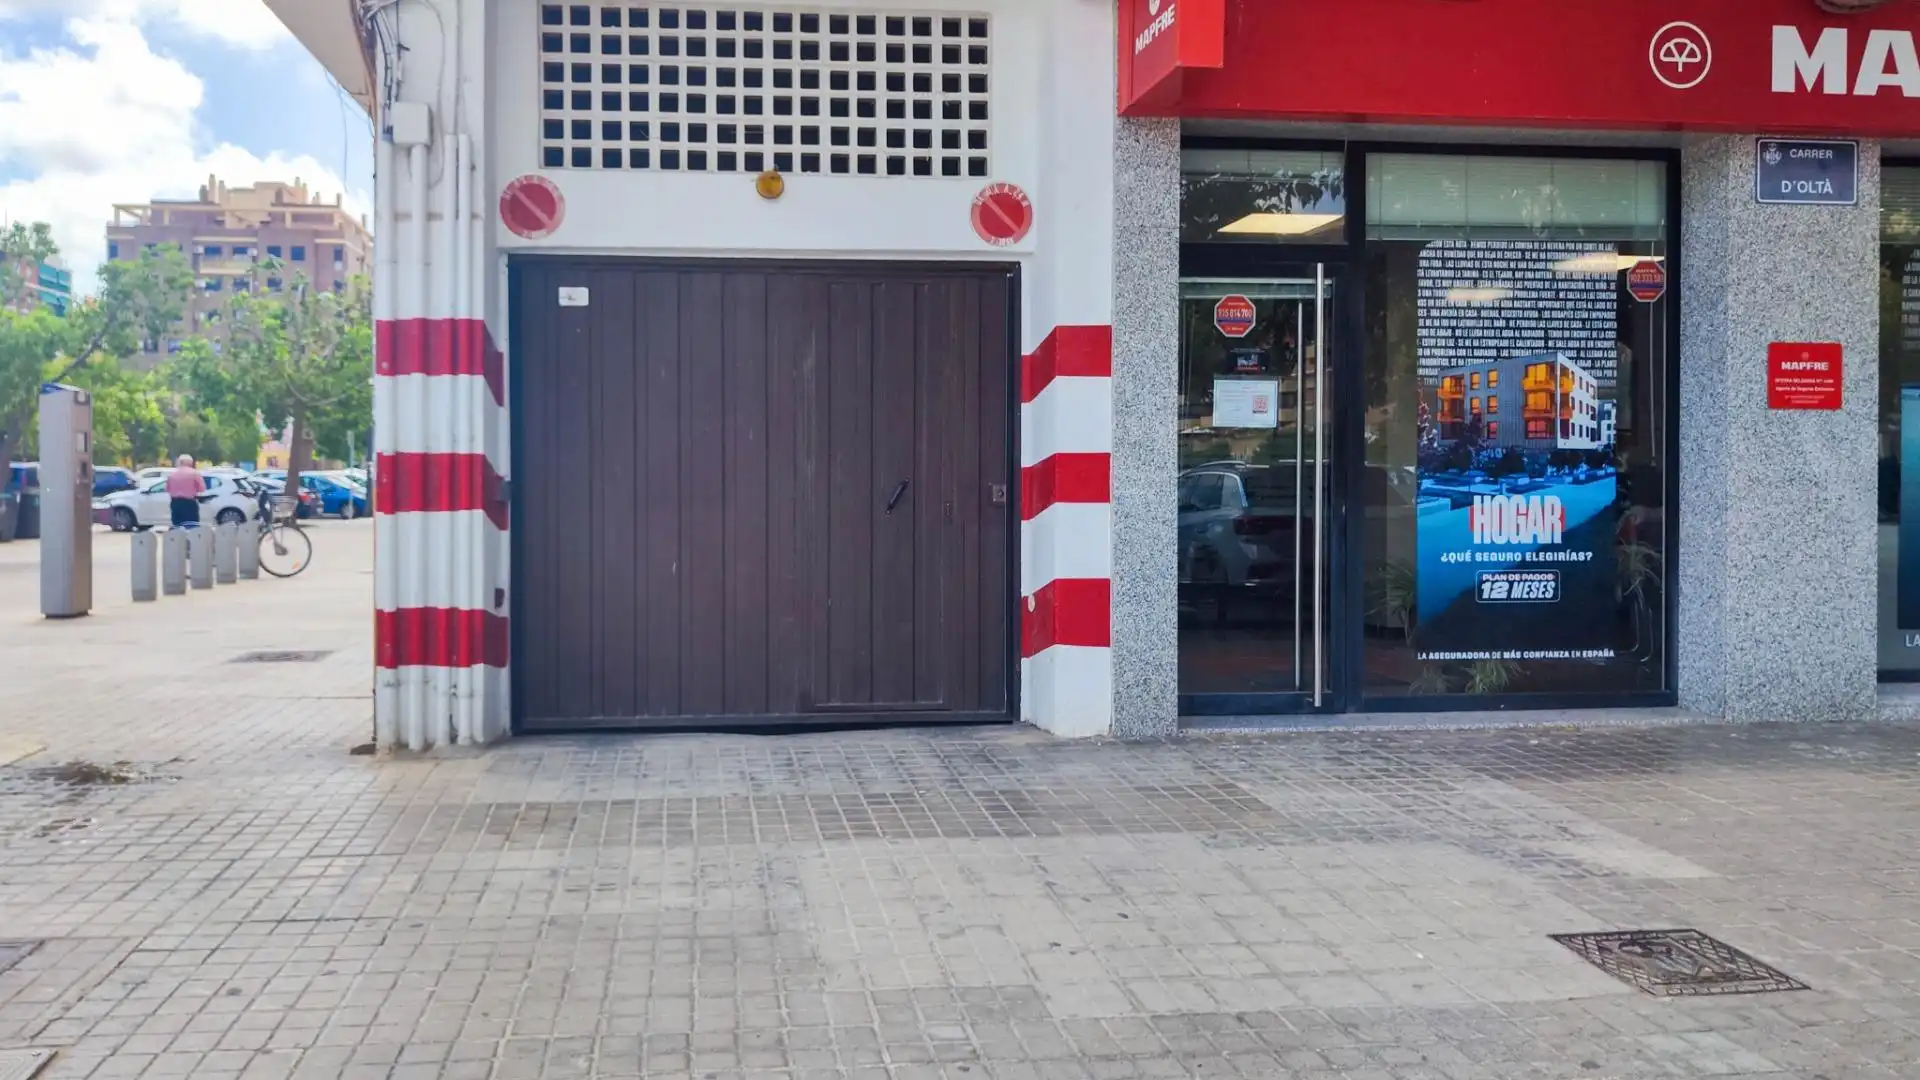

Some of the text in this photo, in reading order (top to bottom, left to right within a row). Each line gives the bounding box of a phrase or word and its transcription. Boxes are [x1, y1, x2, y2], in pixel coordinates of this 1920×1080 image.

[1136, 4, 1176, 55] MAPFRE
[1772, 25, 1920, 98] MA
[1790, 149, 1832, 159] CARRER
[1782, 178, 1832, 194] D'OLTÀ
[1781, 361, 1829, 370] MAPFRE
[1474, 495, 1562, 544] HOGAR
[1440, 550, 1593, 563] ¿QUÉ SEGURO ELEGIRÍAS?
[1481, 582, 1556, 598] 12 MESES
[1417, 652, 1426, 660] LA
[1428, 651, 1490, 659] ASEGURADORA
[1503, 650, 1521, 658] MÁS
[1582, 648, 1614, 657] ESPAÑA
